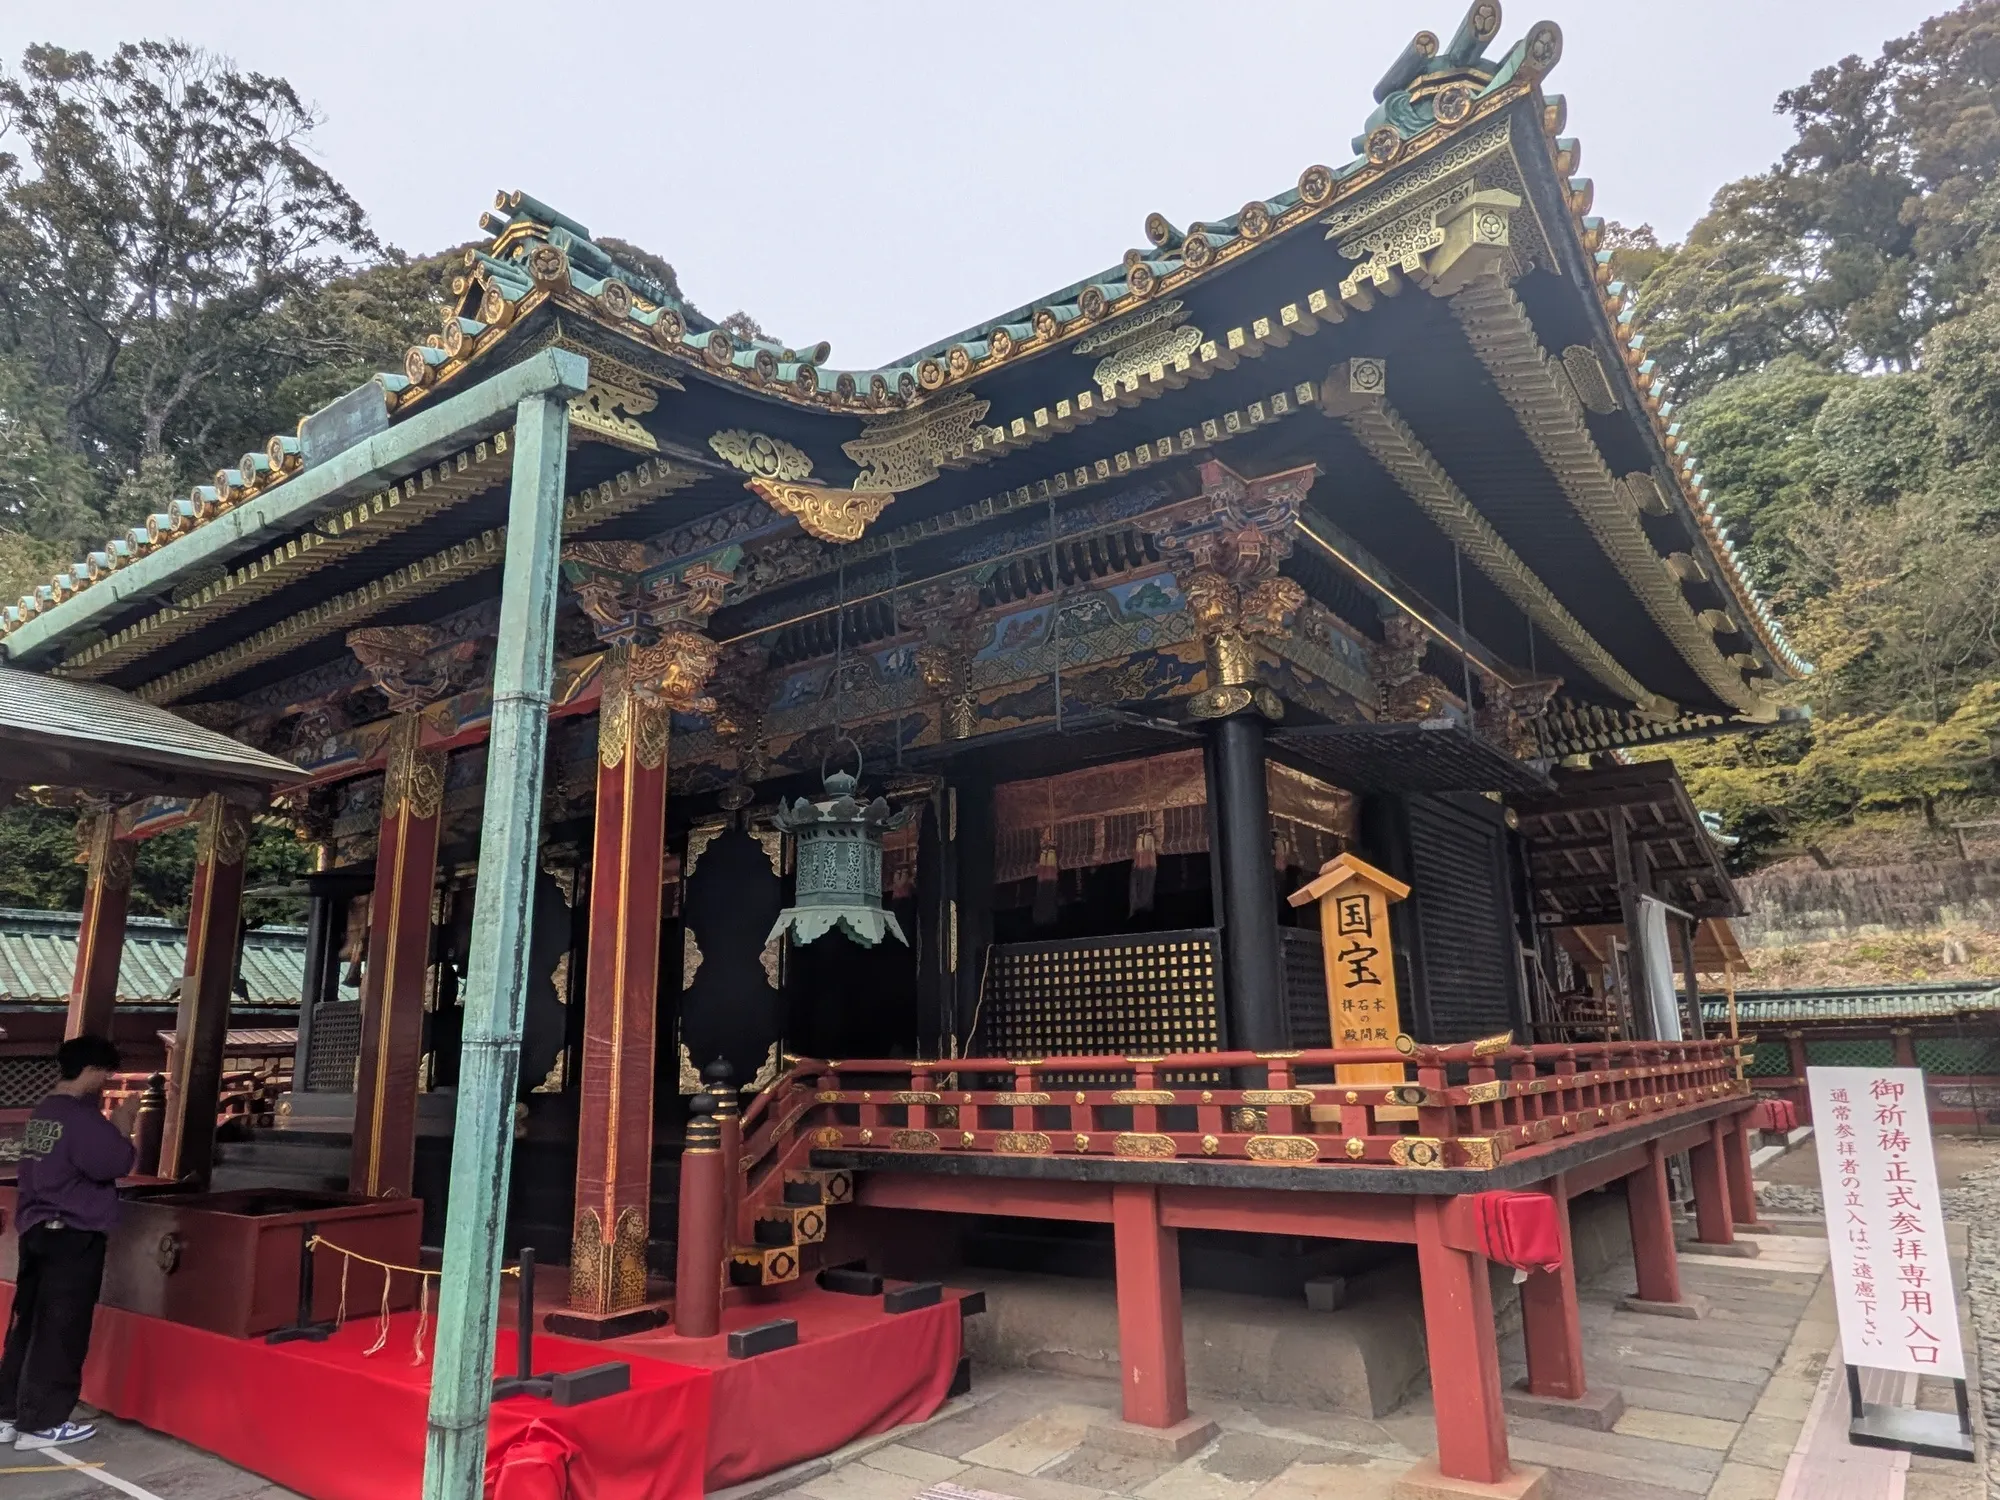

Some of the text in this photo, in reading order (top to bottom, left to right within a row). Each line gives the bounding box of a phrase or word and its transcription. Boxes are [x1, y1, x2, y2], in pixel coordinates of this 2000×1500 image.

[1336, 894, 1383, 988] 国宝
[1829, 1088, 1883, 1347] 通常参拝者の立入はご遠慮下さい
